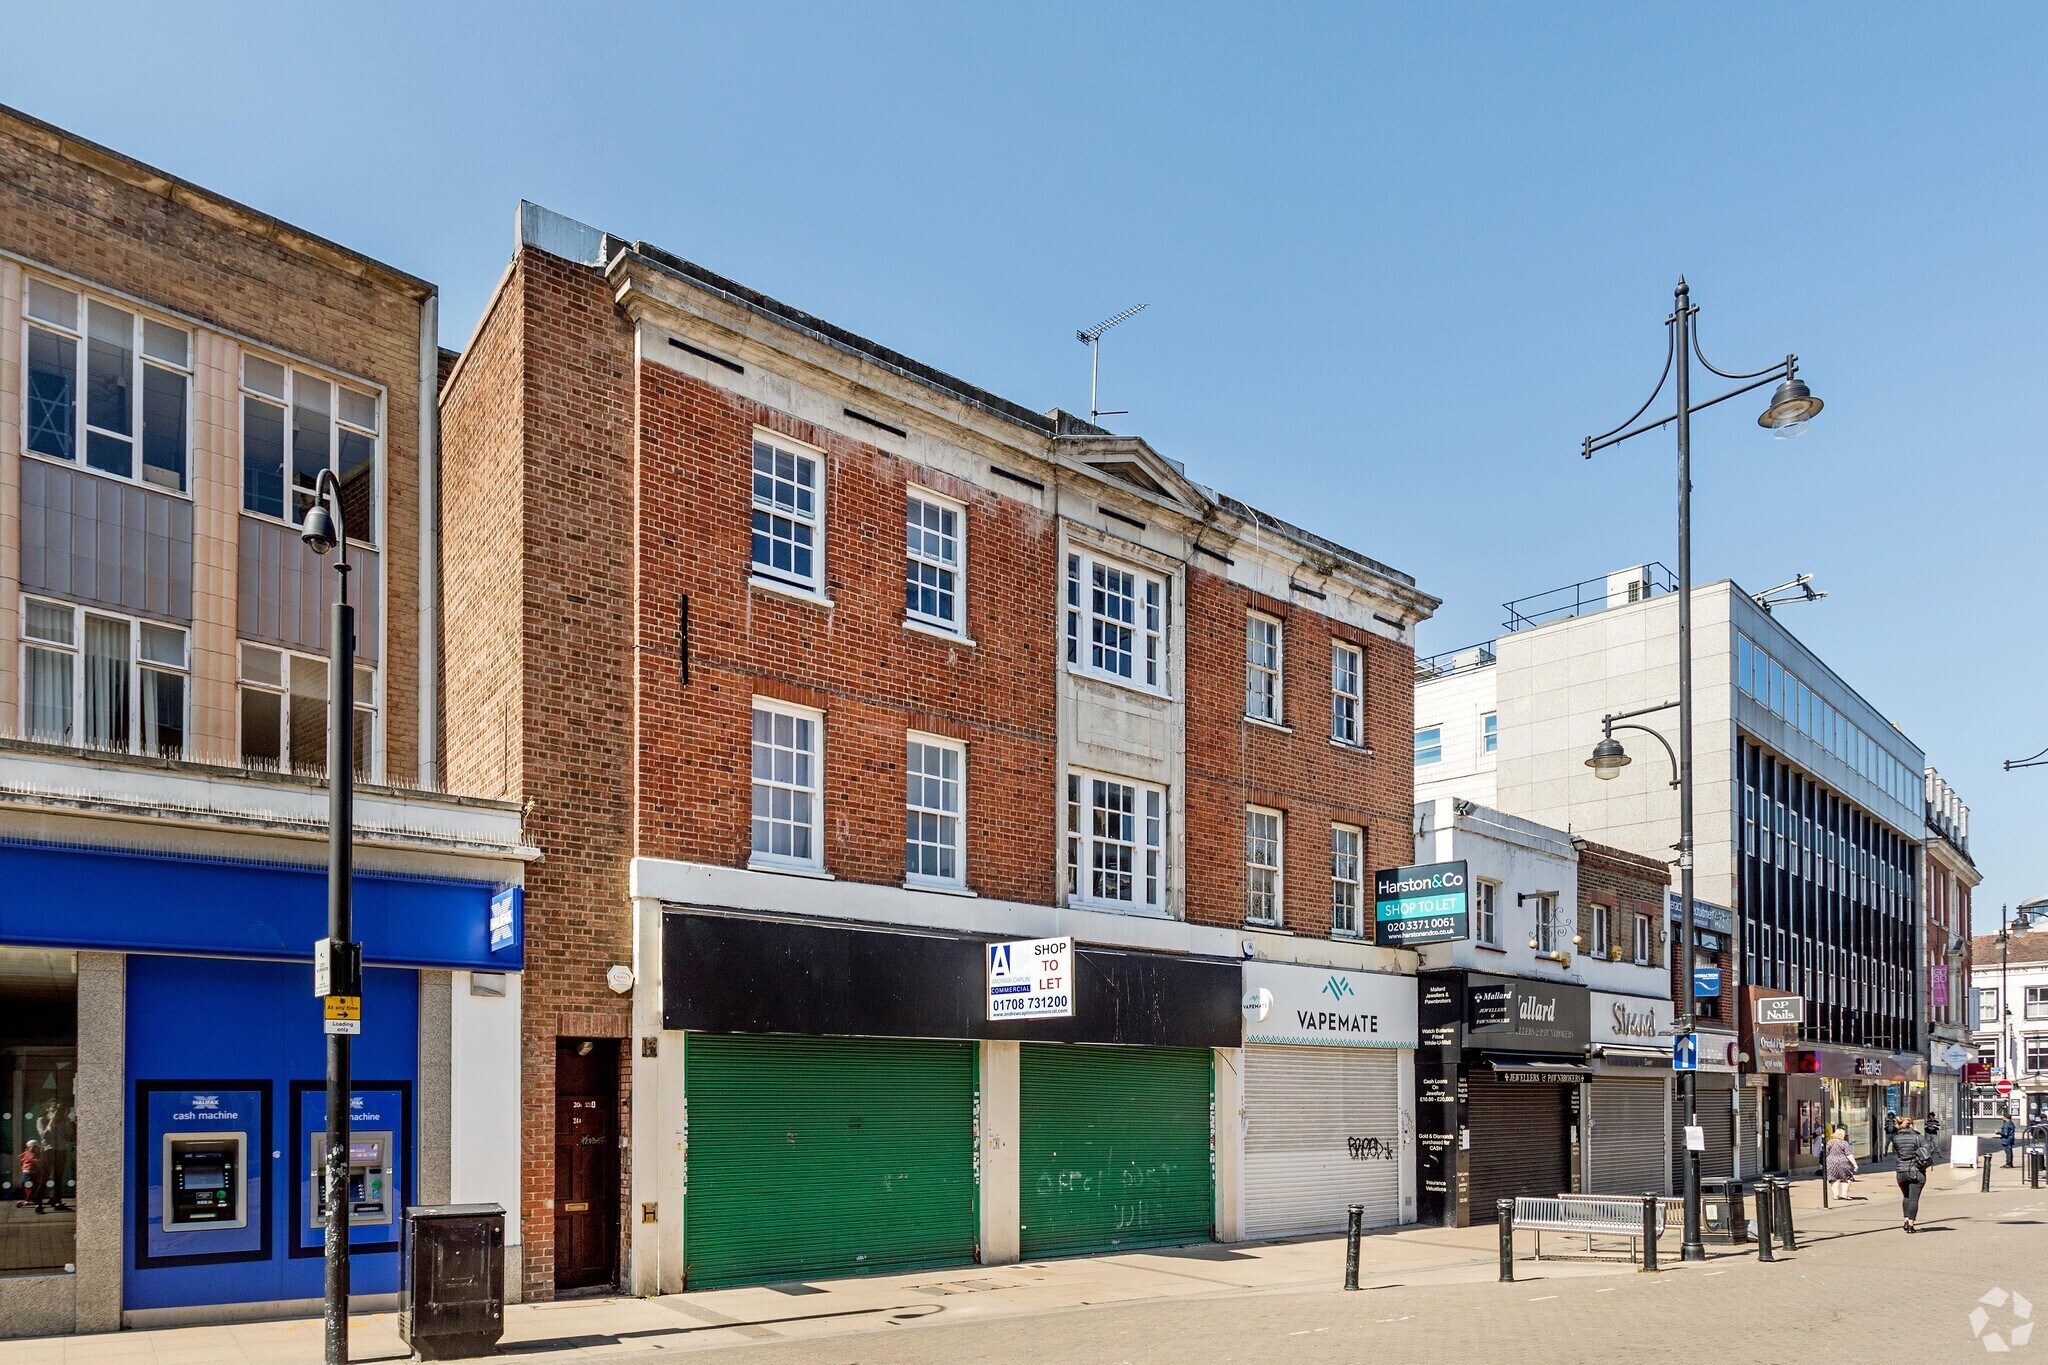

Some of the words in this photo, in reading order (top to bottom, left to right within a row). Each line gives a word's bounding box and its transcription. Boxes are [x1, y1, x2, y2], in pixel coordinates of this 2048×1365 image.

[1378, 872, 1463, 895] Harston&Co
[1385, 902, 1415, 916] SHOP
[1418, 900, 1434, 913] TO
[1436, 898, 1457, 911] LET
[1388, 922, 1405, 932] 020
[1406, 920, 1429, 930] 3371
[1431, 917, 1455, 927] 0061
[1034, 943, 1067, 956] SHOP
[1042, 960, 1058, 971] TO
[991, 977, 1013, 985] ANDREW
[1039, 977, 1062, 990] LET
[991, 985, 1030, 994] COMMERCIAL
[1482, 990, 1512, 1001] Mallard
[993, 998, 1024, 1011] 01708
[1028, 995, 1068, 1009] 731200
[1518, 995, 1556, 1022] allard
[1297, 1010, 1378, 1033] VAPEMATE
[1766, 1010, 1795, 1020] Nails
[173, 1111, 196, 1120] cash
[198, 1110, 239, 1120] machine
